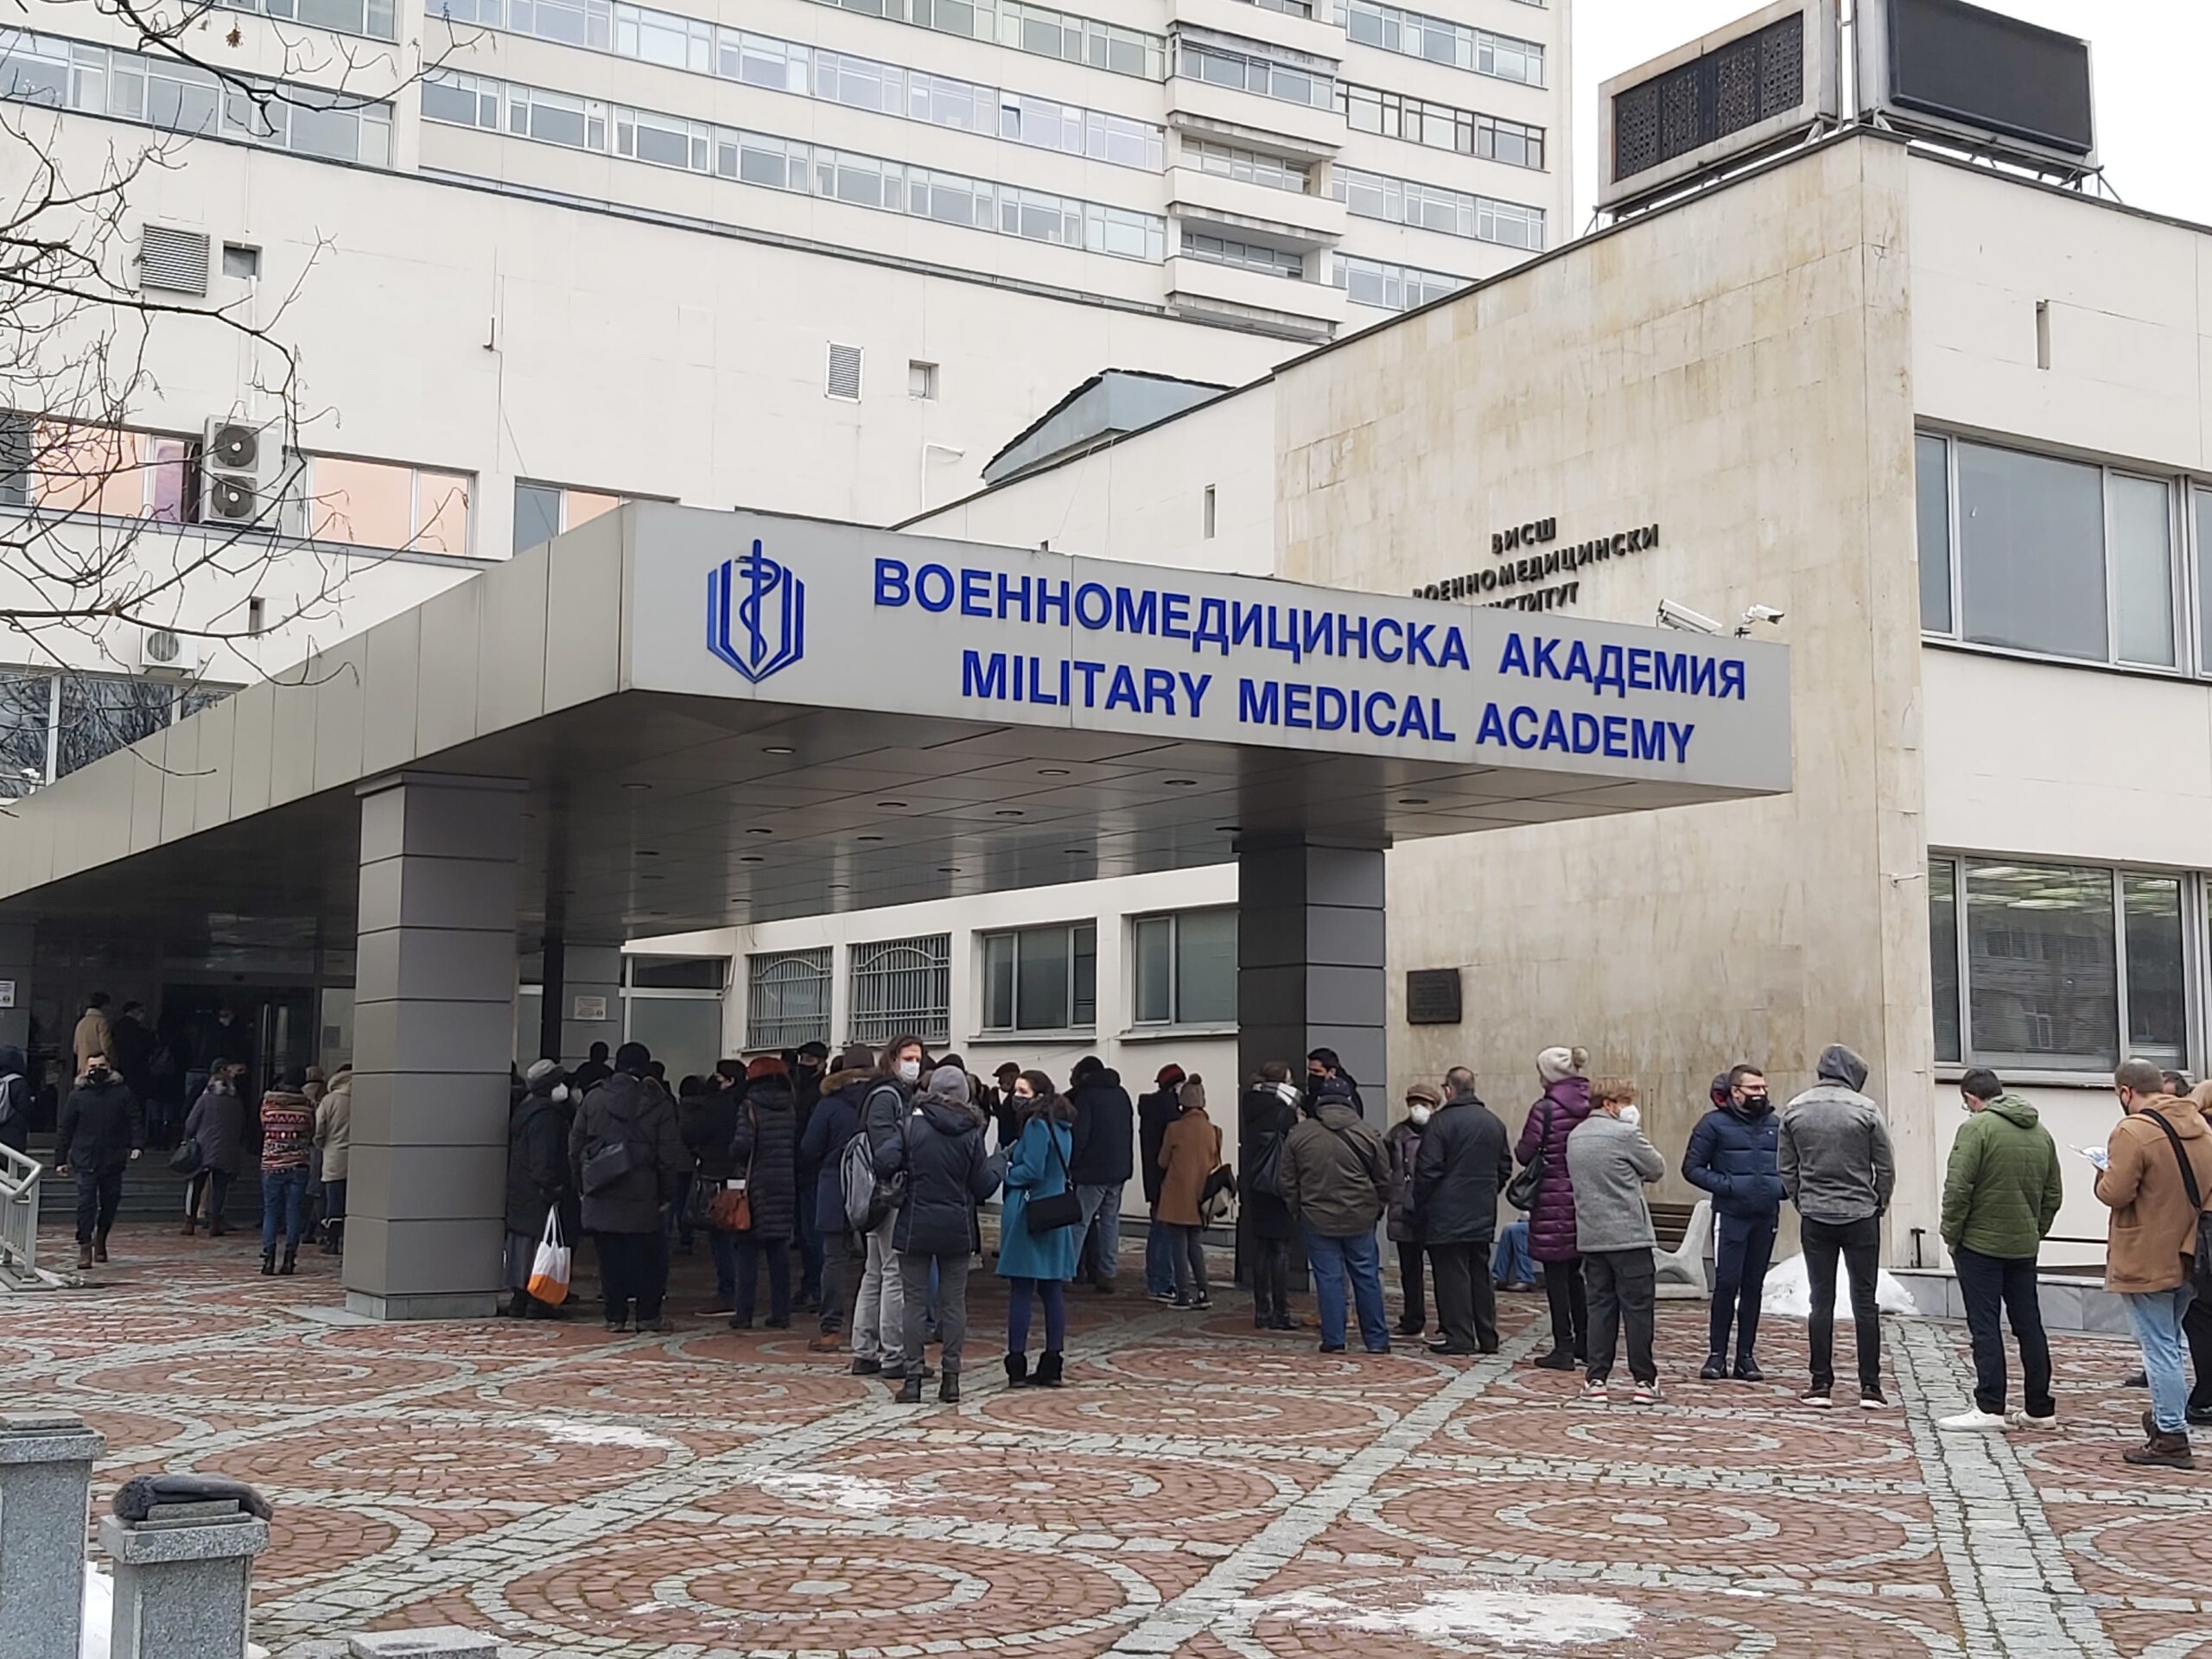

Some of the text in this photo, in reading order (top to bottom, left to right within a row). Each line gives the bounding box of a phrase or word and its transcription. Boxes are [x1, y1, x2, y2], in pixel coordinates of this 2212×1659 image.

[1491, 517, 1556, 555] ВИСШ
[873, 557, 1746, 699] ВОЕННОМЕДИЦИНСКА АКАДЕМИЯ
[962, 649, 1694, 761] MILITARY MEDICAL ACADEMY
